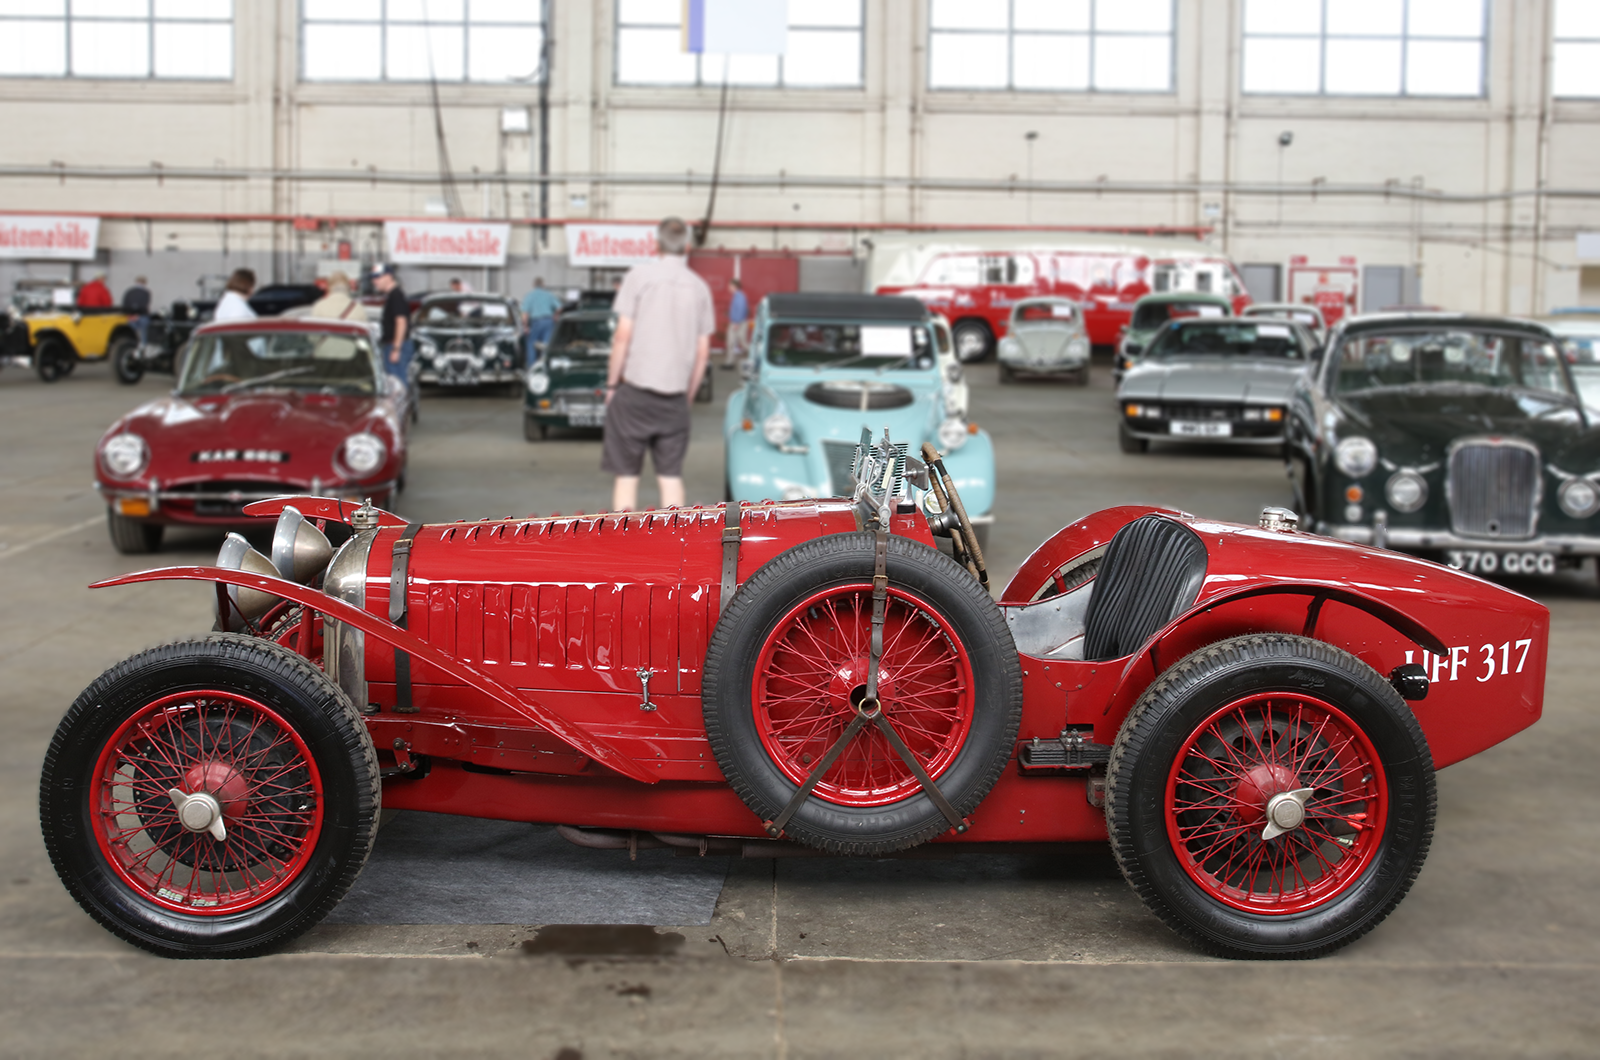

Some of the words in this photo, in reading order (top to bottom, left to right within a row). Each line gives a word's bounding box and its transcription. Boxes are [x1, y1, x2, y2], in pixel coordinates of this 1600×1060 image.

[0, 221, 91, 250] utomobile
[394, 227, 502, 256] Automobile
[1446, 551, 1497, 573] 370
[1502, 553, 1555, 574] GCG
[1476, 638, 1532, 682] 317
